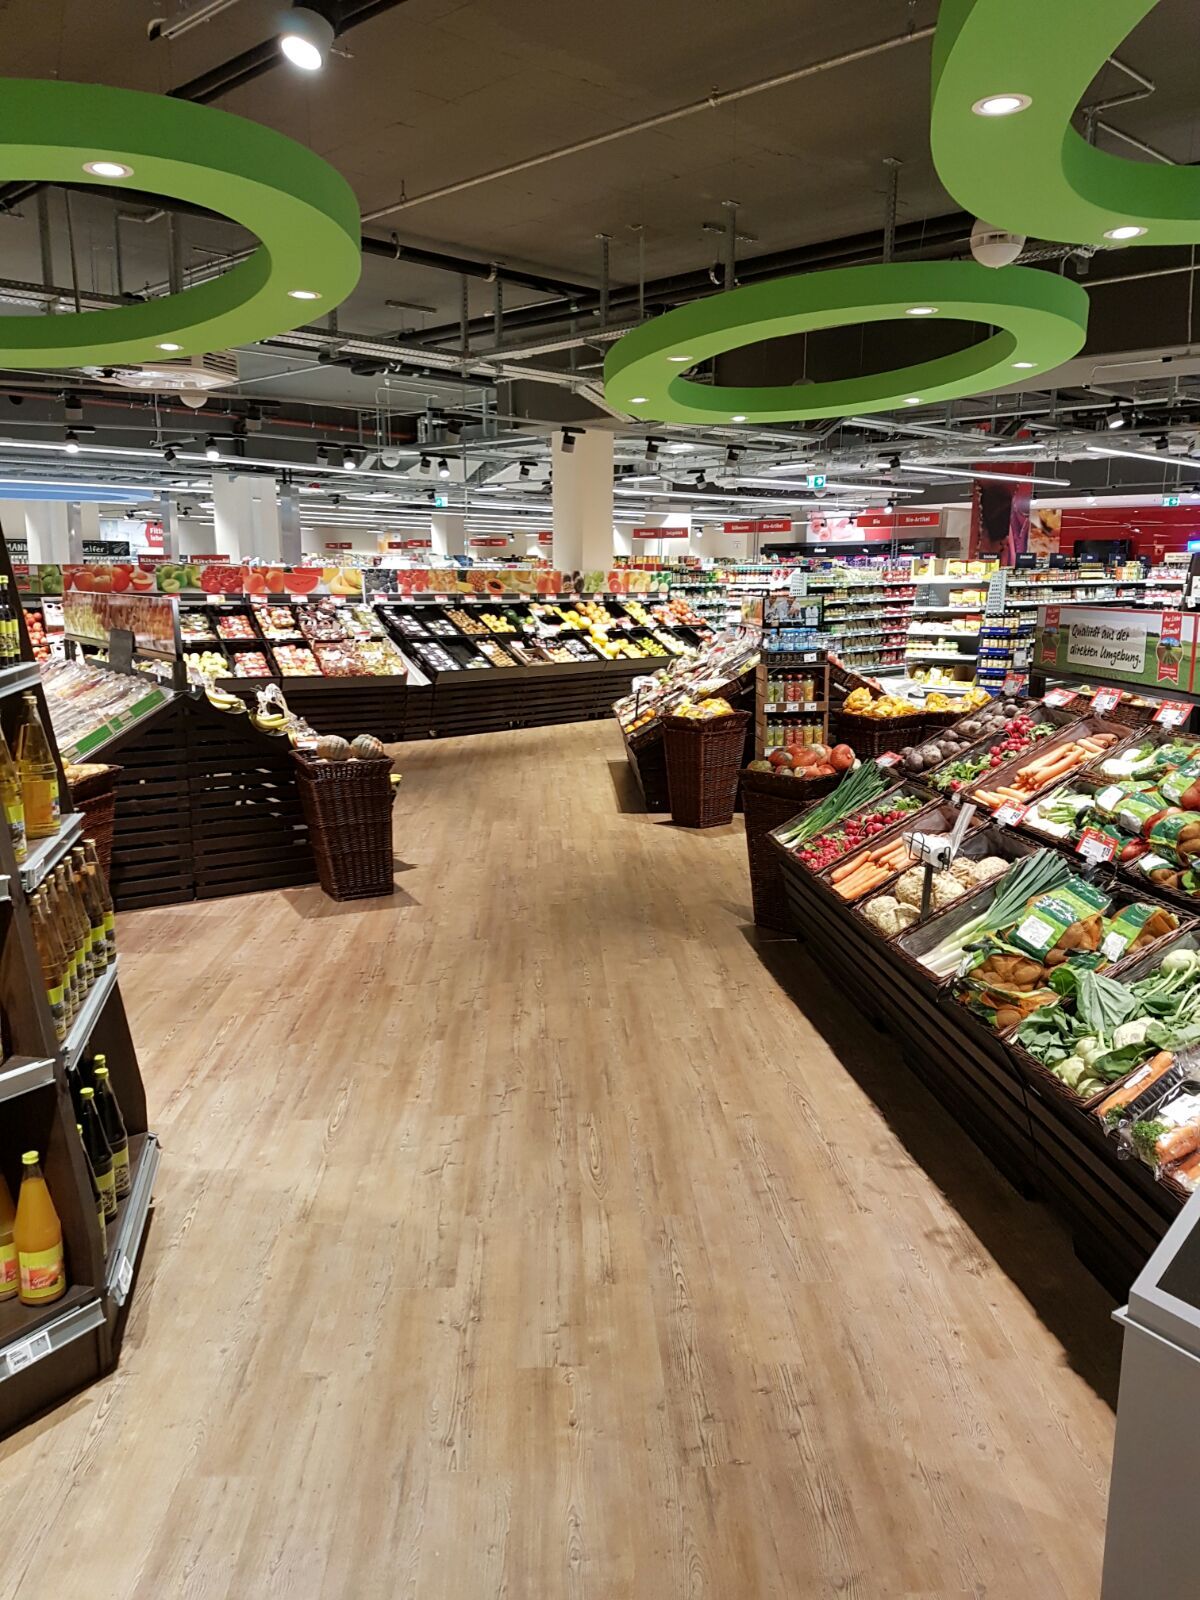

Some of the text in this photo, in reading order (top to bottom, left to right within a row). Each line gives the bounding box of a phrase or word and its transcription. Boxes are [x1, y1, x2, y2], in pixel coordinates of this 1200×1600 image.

[1071, 623, 1130, 641] Qualität aus der
[1069, 643, 1142, 669] direkten Umgebung.
